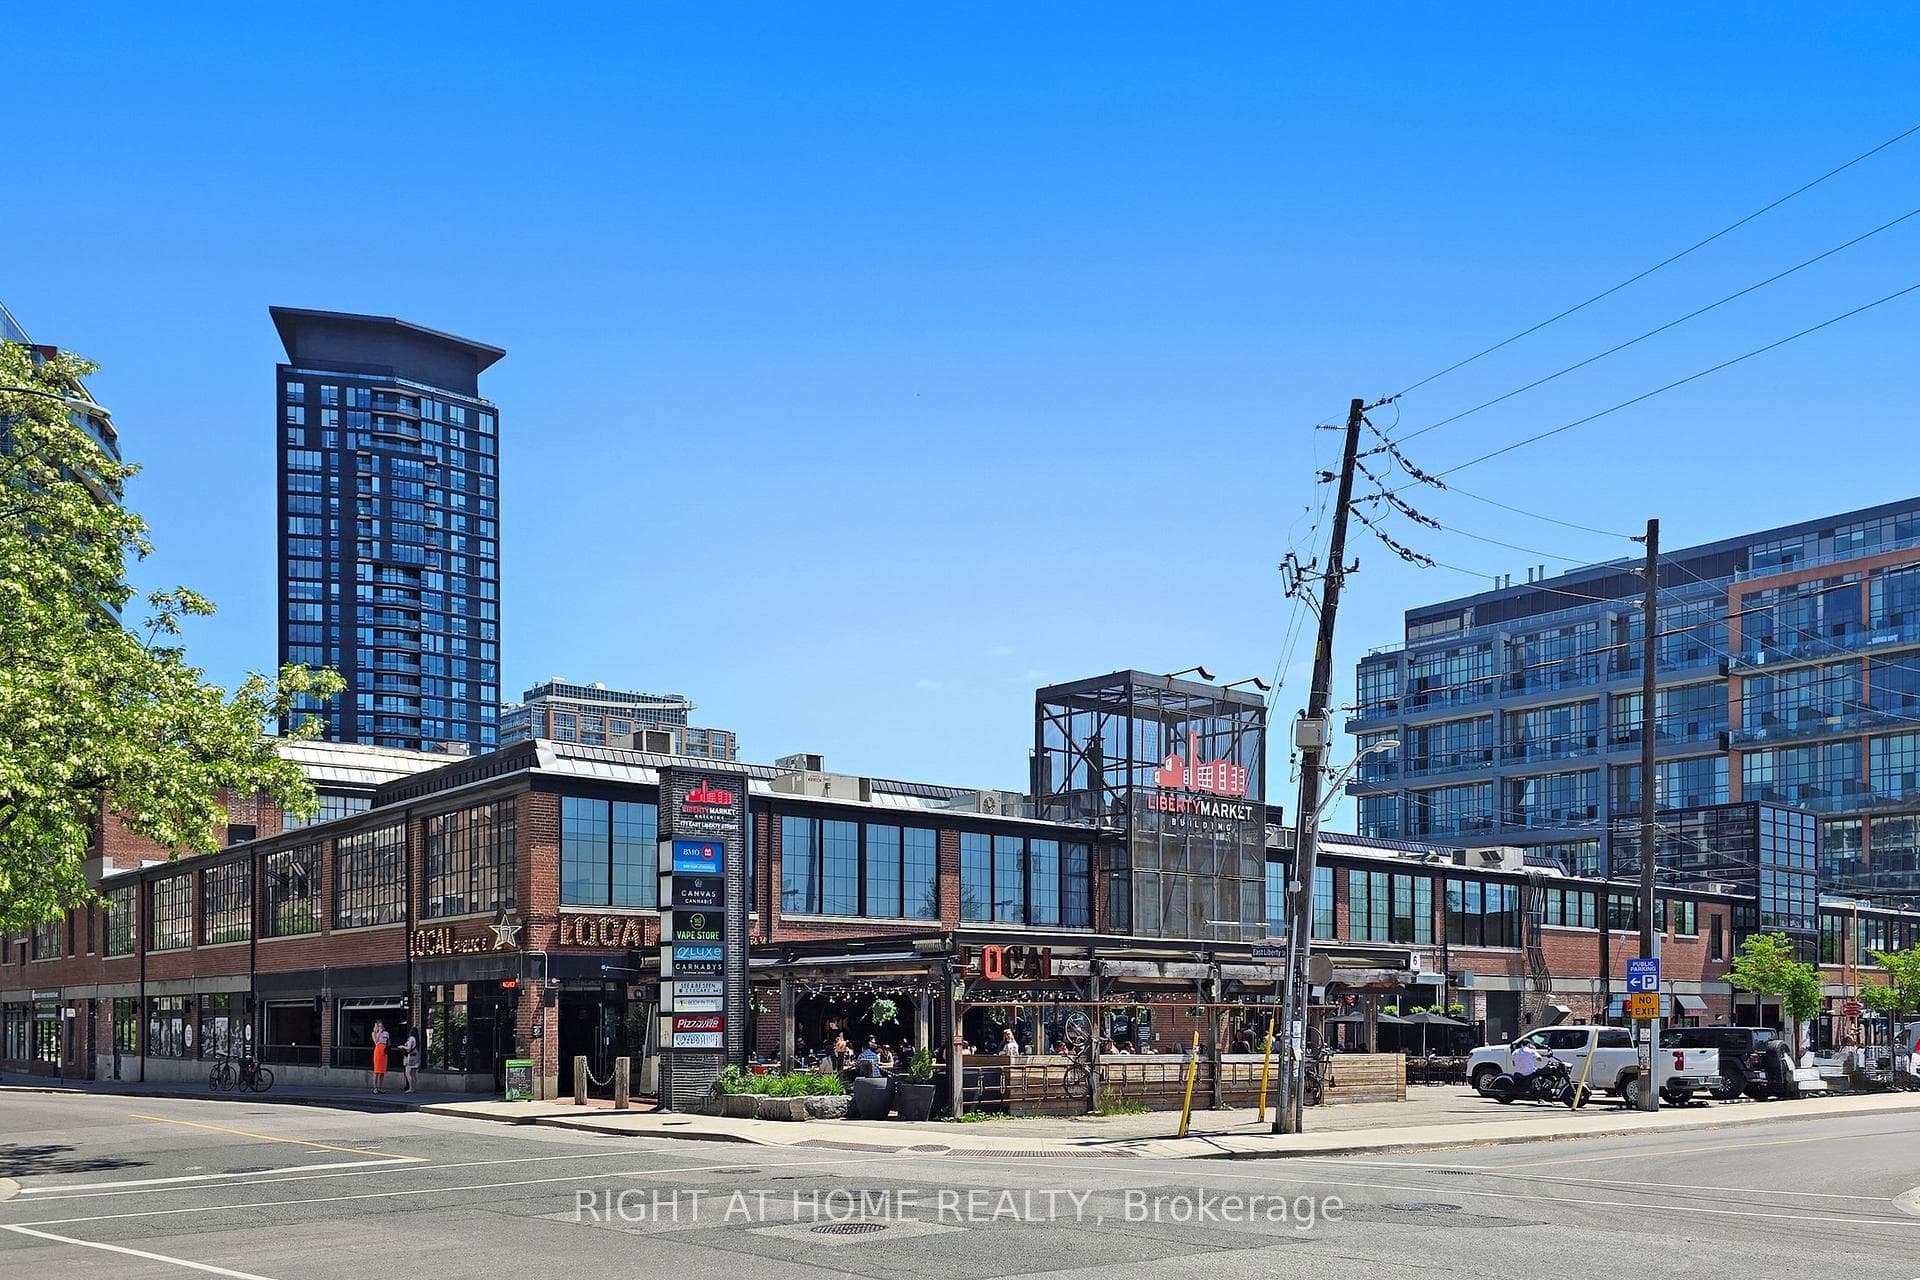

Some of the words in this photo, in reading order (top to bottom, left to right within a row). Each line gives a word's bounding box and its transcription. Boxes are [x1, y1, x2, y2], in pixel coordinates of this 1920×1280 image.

[1171, 818, 1232, 832] BUILDING
[683, 848, 700, 856] BMO
[681, 889, 716, 898] CANVAS
[560, 915, 660, 947] LOCAL
[676, 930, 696, 940] VAPE
[696, 931, 720, 940] STORE
[409, 927, 452, 957] LOCAL
[1412, 954, 1418, 965] 6
[1644, 976, 1655, 989] P
[1638, 996, 1652, 1004] NO
[1635, 1007, 1656, 1016] EXIT
